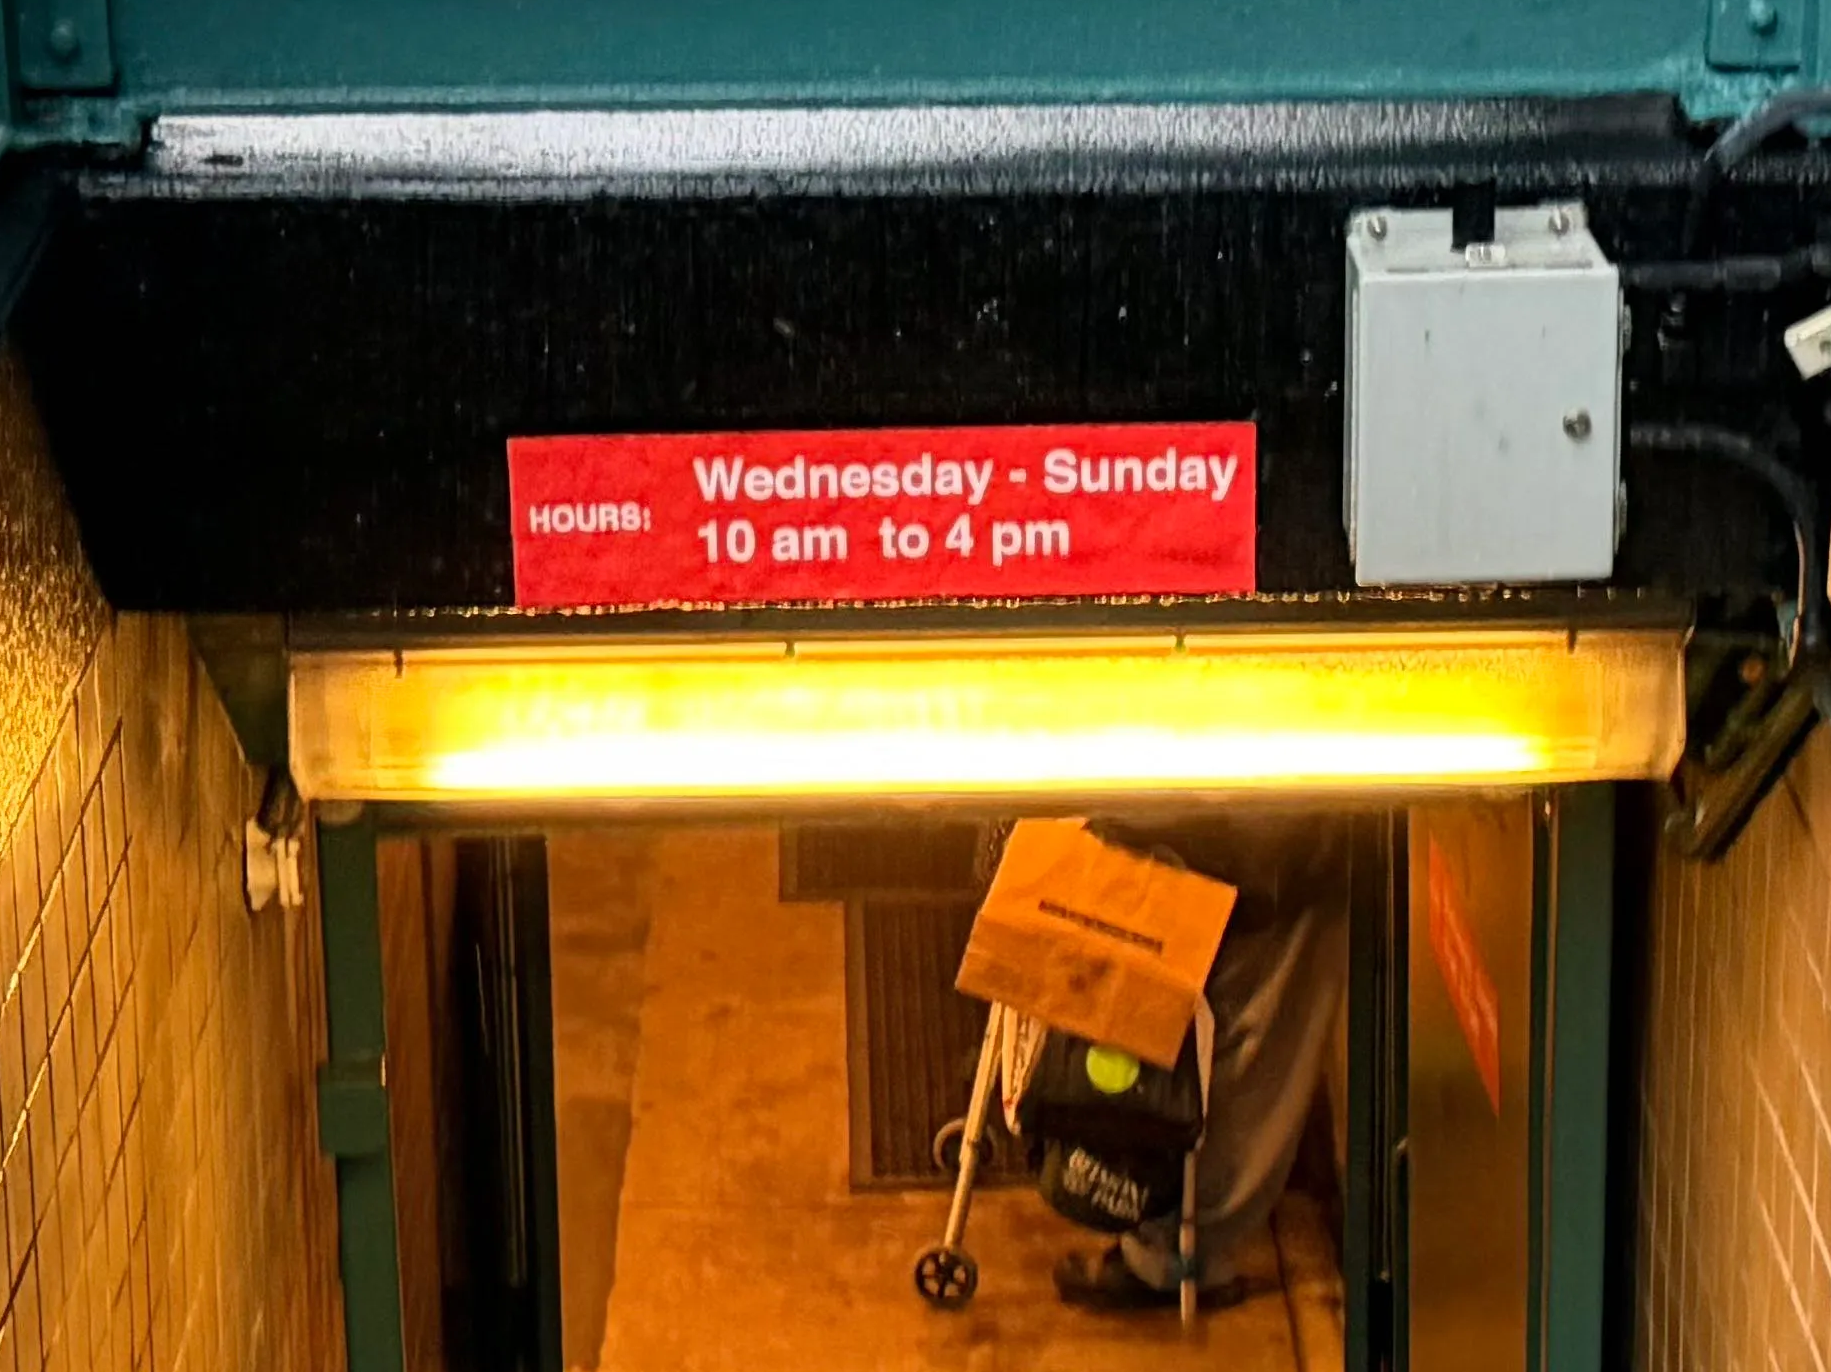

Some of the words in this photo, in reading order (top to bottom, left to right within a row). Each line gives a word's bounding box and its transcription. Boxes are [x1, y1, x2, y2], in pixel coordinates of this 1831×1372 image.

[693, 452, 993, 504] Wednesday
[1010, 471, 1026, 483] -
[1044, 448, 1237, 502] Sunday
[529, 503, 651, 534] HOURS:
[697, 519, 755, 564] 10
[771, 525, 848, 562] am
[878, 516, 928, 559] to
[945, 514, 974, 557] 4
[992, 517, 1071, 566] pm
